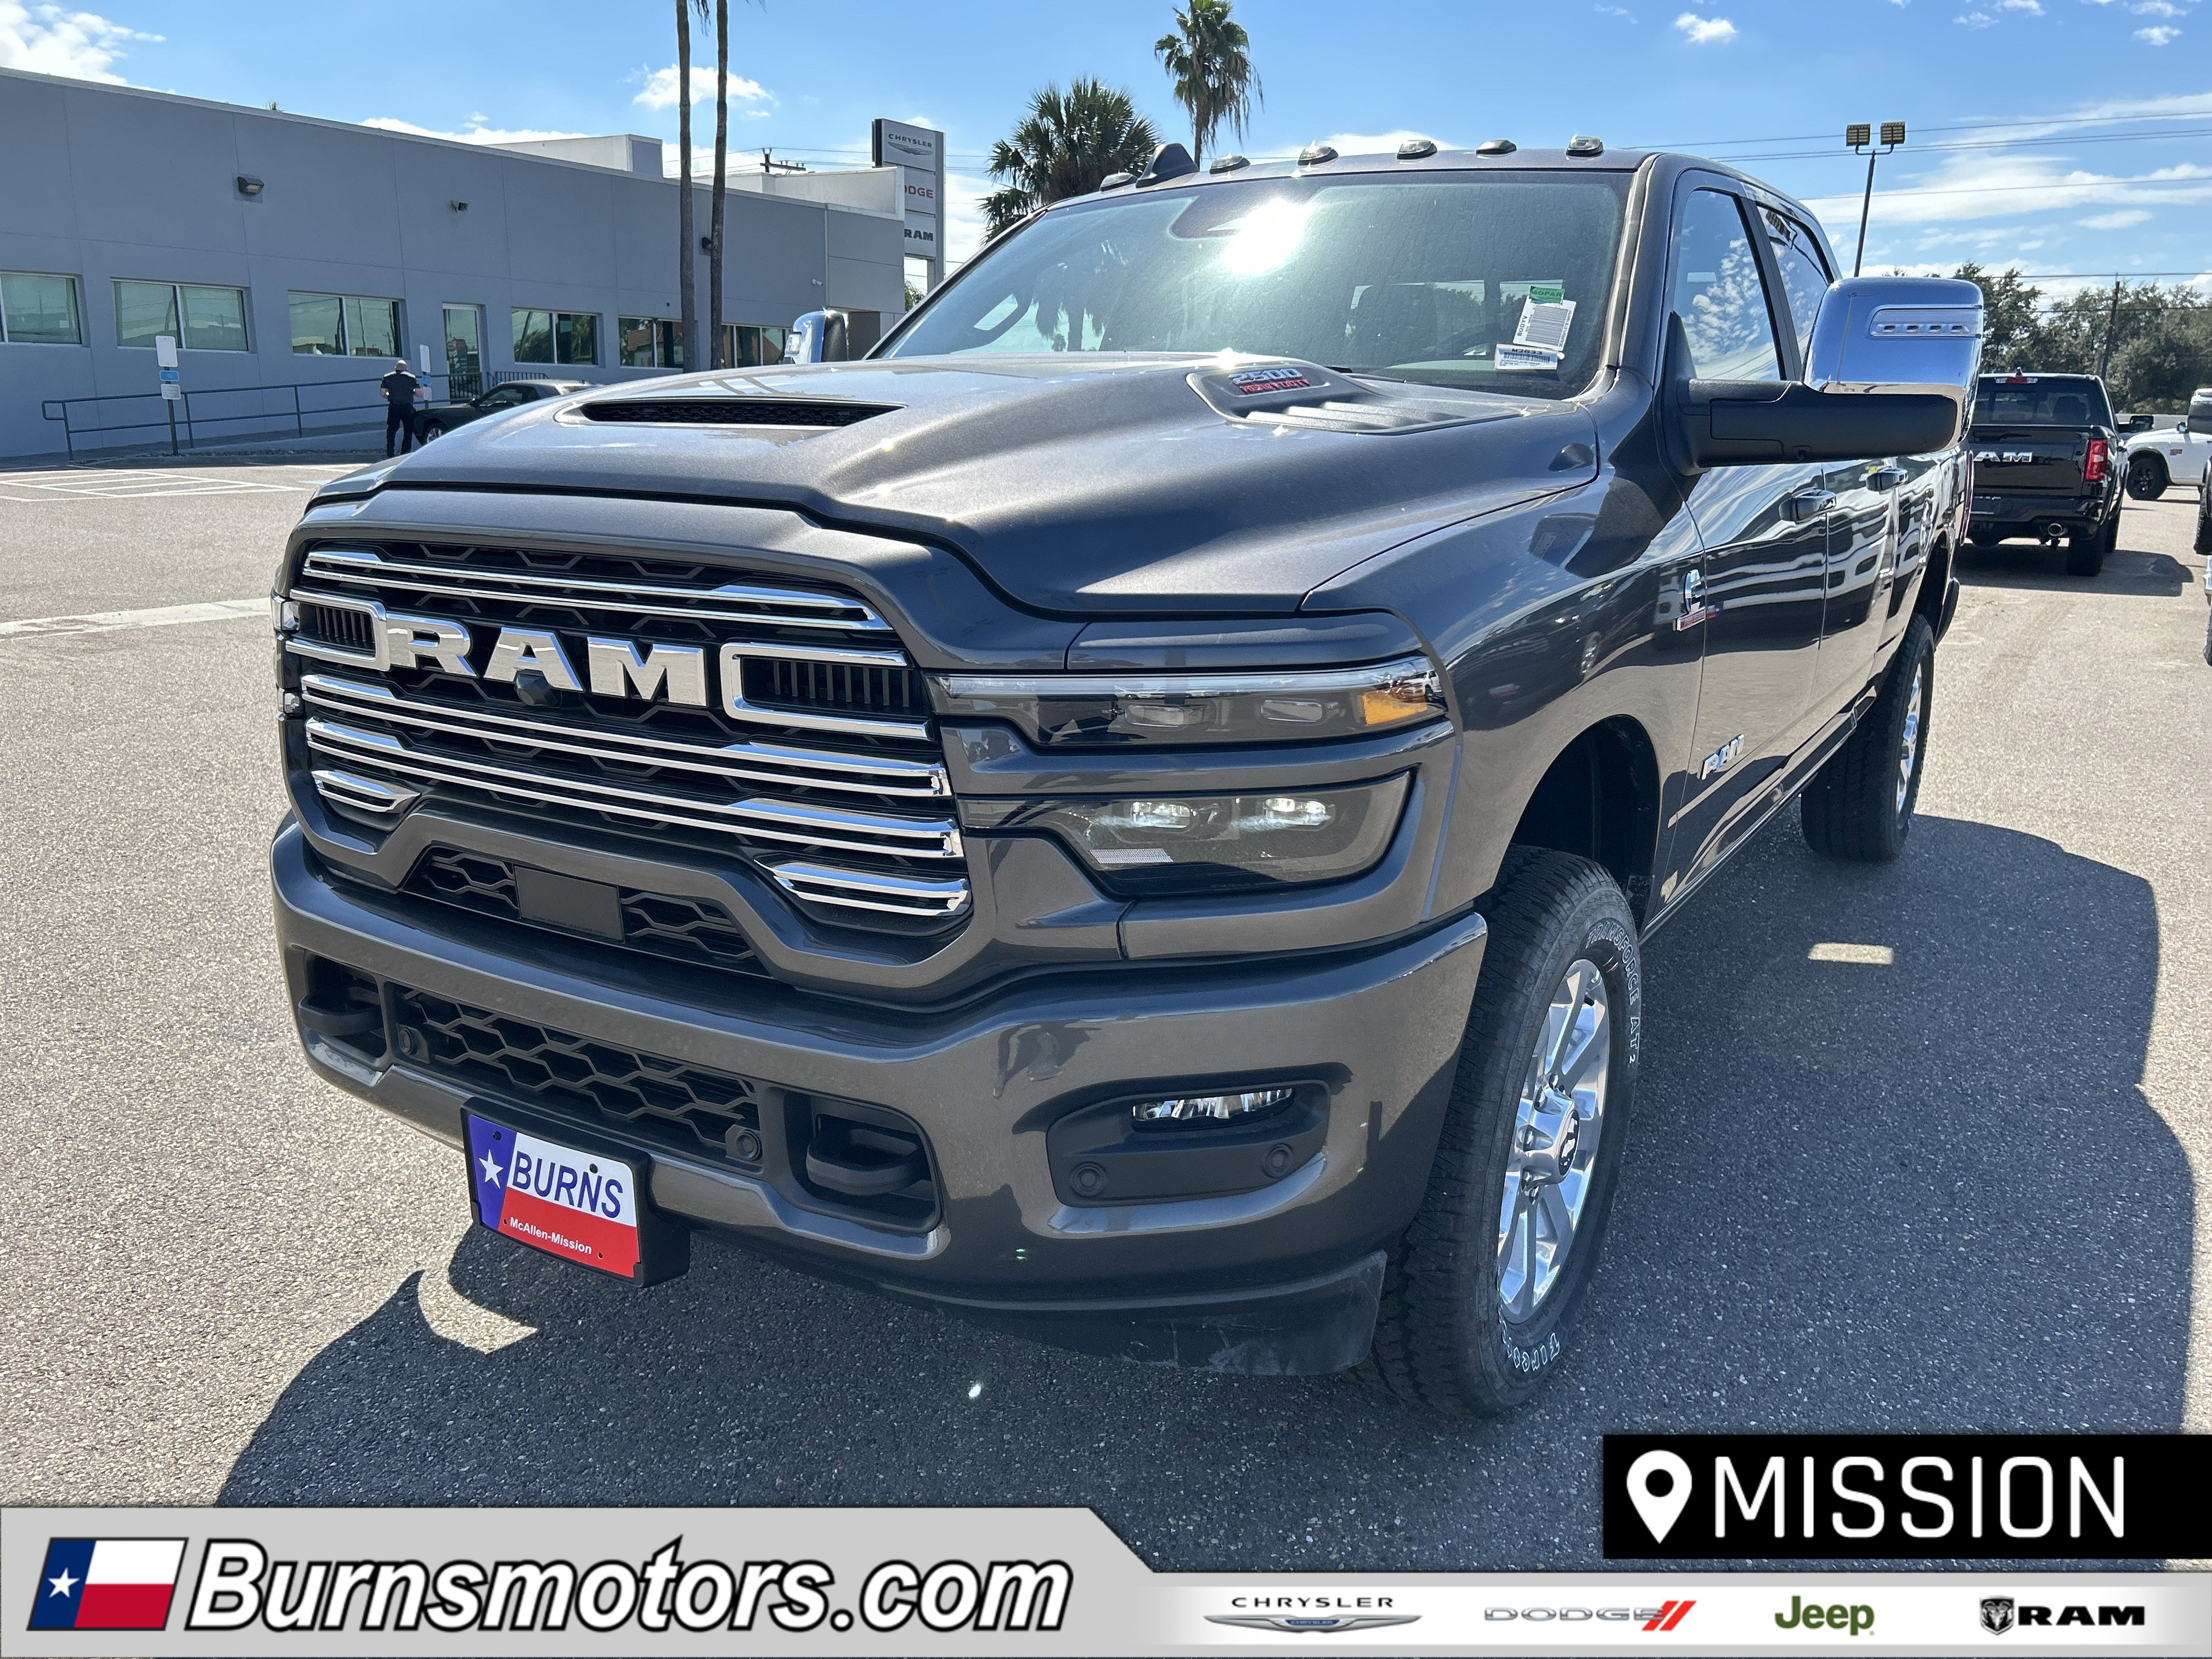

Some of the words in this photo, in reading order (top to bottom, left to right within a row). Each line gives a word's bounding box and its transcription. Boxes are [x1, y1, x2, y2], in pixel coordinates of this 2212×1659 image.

[888, 133, 932, 148] CHRYSLER
[904, 228, 933, 241] RAM
[1228, 368, 1303, 385] 2500
[1239, 382, 1280, 394] HEAVY
[1279, 379, 1311, 390] DUTY
[1973, 451, 2033, 462] AM
[385, 611, 707, 707] RAM
[1700, 734, 1745, 780] RAM
[1585, 921, 1640, 1006] TRANSFORCE
[1630, 1017, 1640, 1049] AT
[1629, 1054, 1636, 1064] 2
[512, 1150, 623, 1218] BURNS
[510, 1216, 592, 1255] McAllen-Mission
